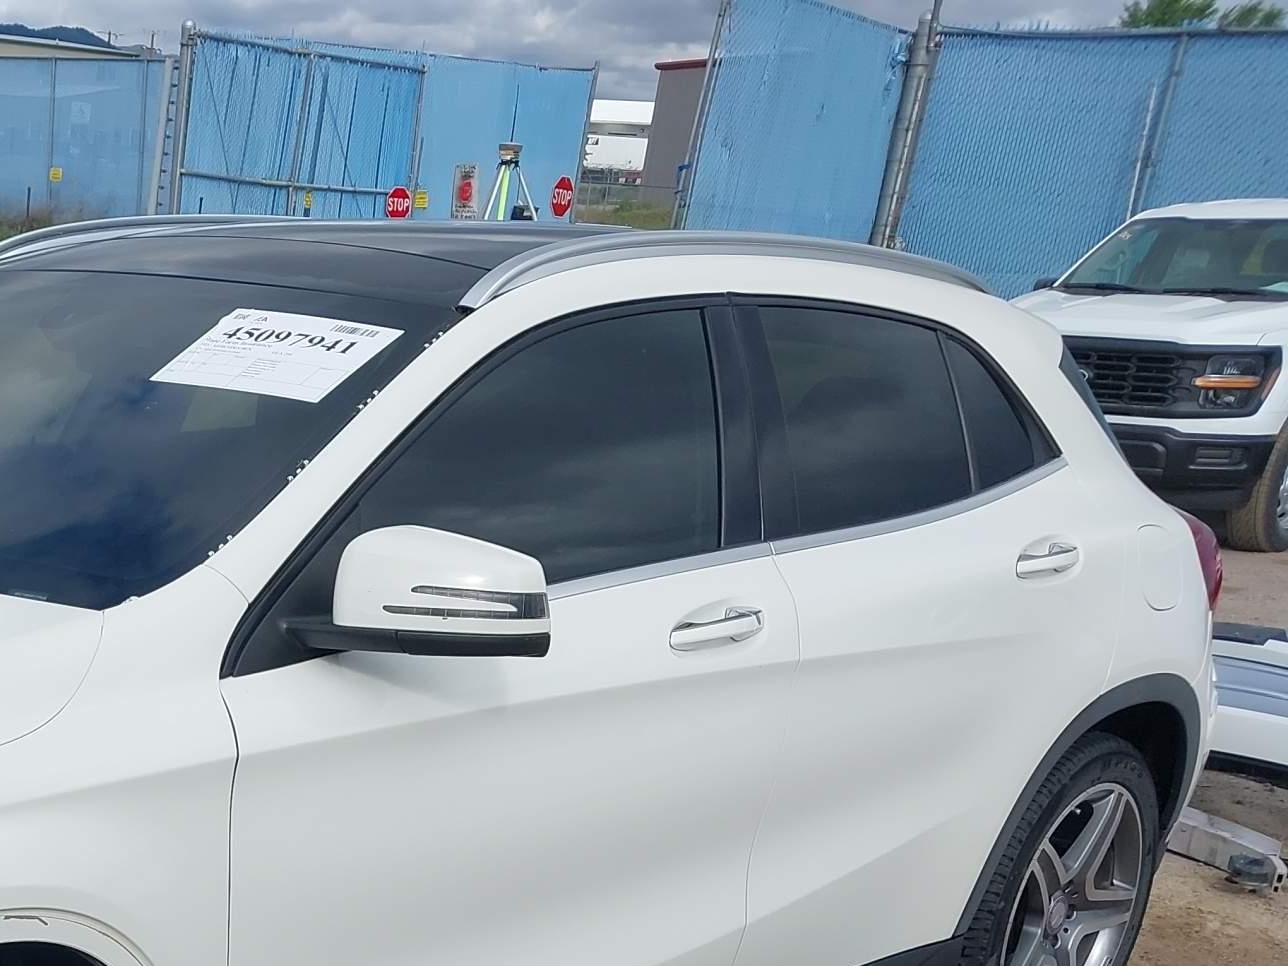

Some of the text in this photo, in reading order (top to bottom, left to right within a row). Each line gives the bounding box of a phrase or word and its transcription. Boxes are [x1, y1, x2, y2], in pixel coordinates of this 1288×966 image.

[387, 197, 410, 212] STOP
[552, 188, 573, 205] STOP
[223, 327, 357, 354] 45097941
